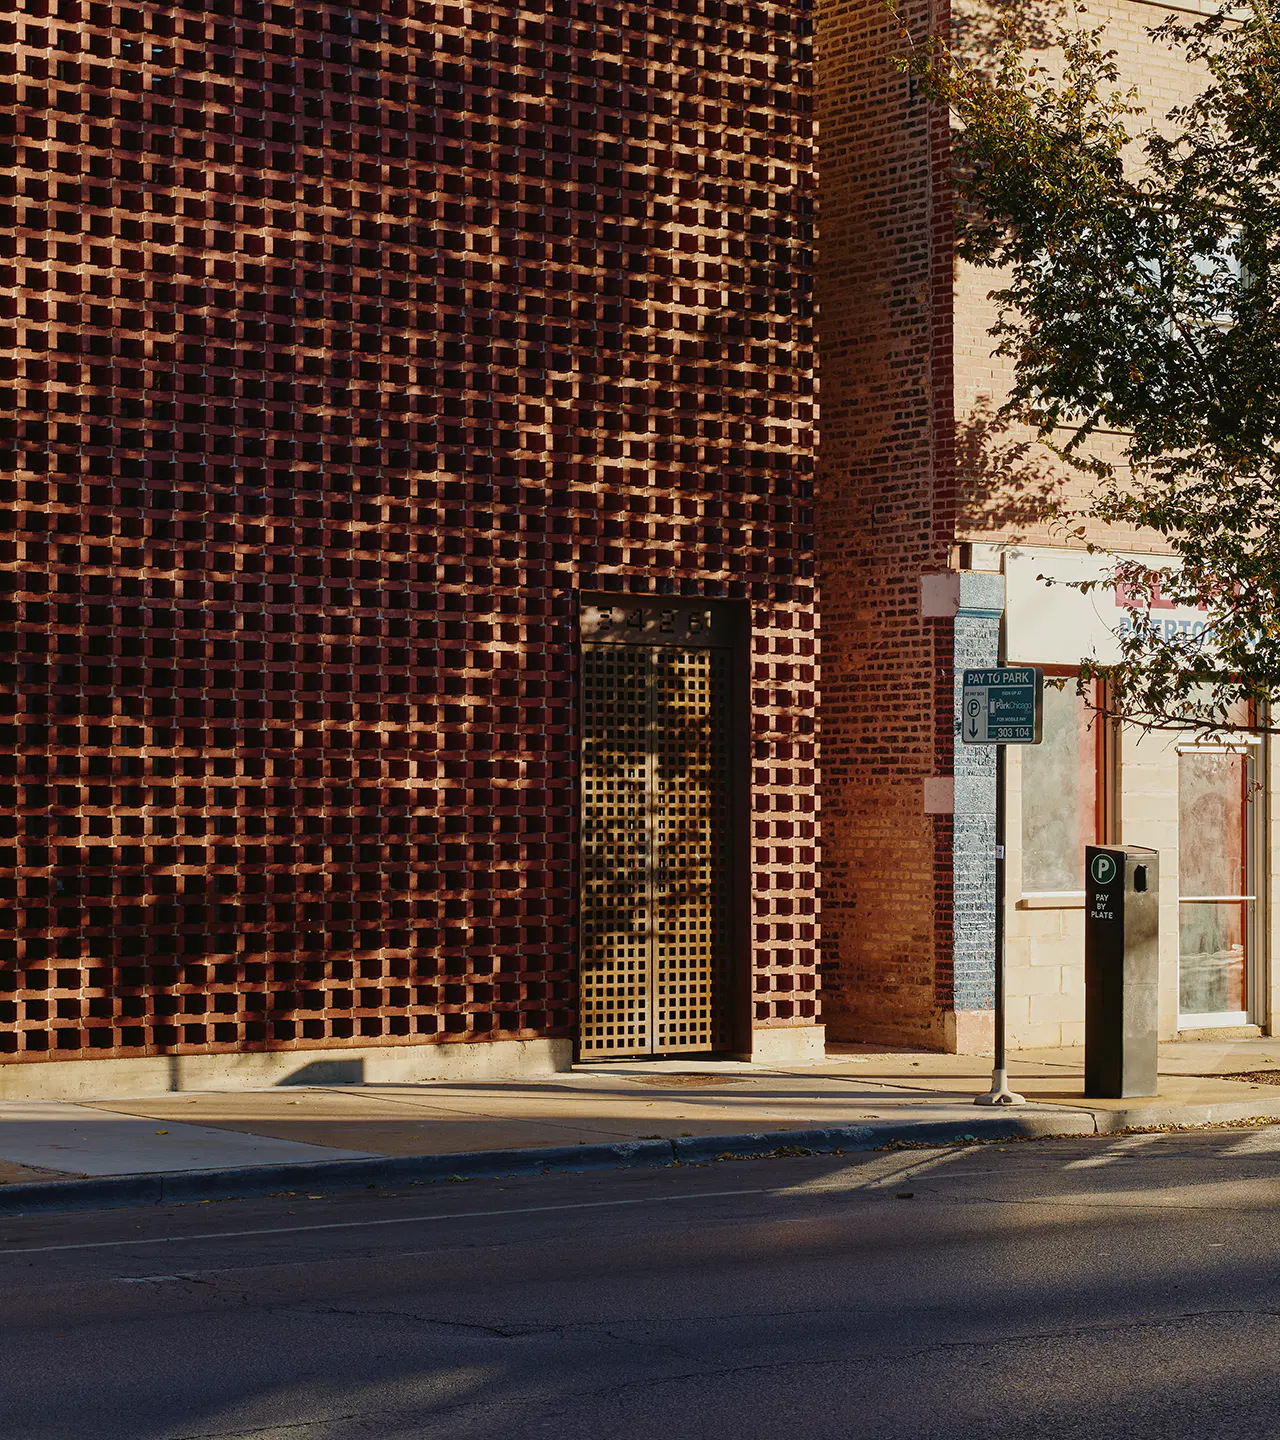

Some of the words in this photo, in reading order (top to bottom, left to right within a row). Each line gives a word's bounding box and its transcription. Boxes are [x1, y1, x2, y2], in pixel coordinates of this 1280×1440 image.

[597, 606, 703, 634] 3426
[967, 673, 985, 684] PAY
[987, 672, 1001, 684] TO
[1002, 671, 1029, 683] PARK
[995, 701, 1032, 711] ParkChicago
[998, 727, 1013, 737] 303
[1015, 727, 1029, 737] 104
[1098, 859, 1110, 879] P
[1095, 893, 1109, 901] PAY
[1090, 911, 1114, 919] PLATE
